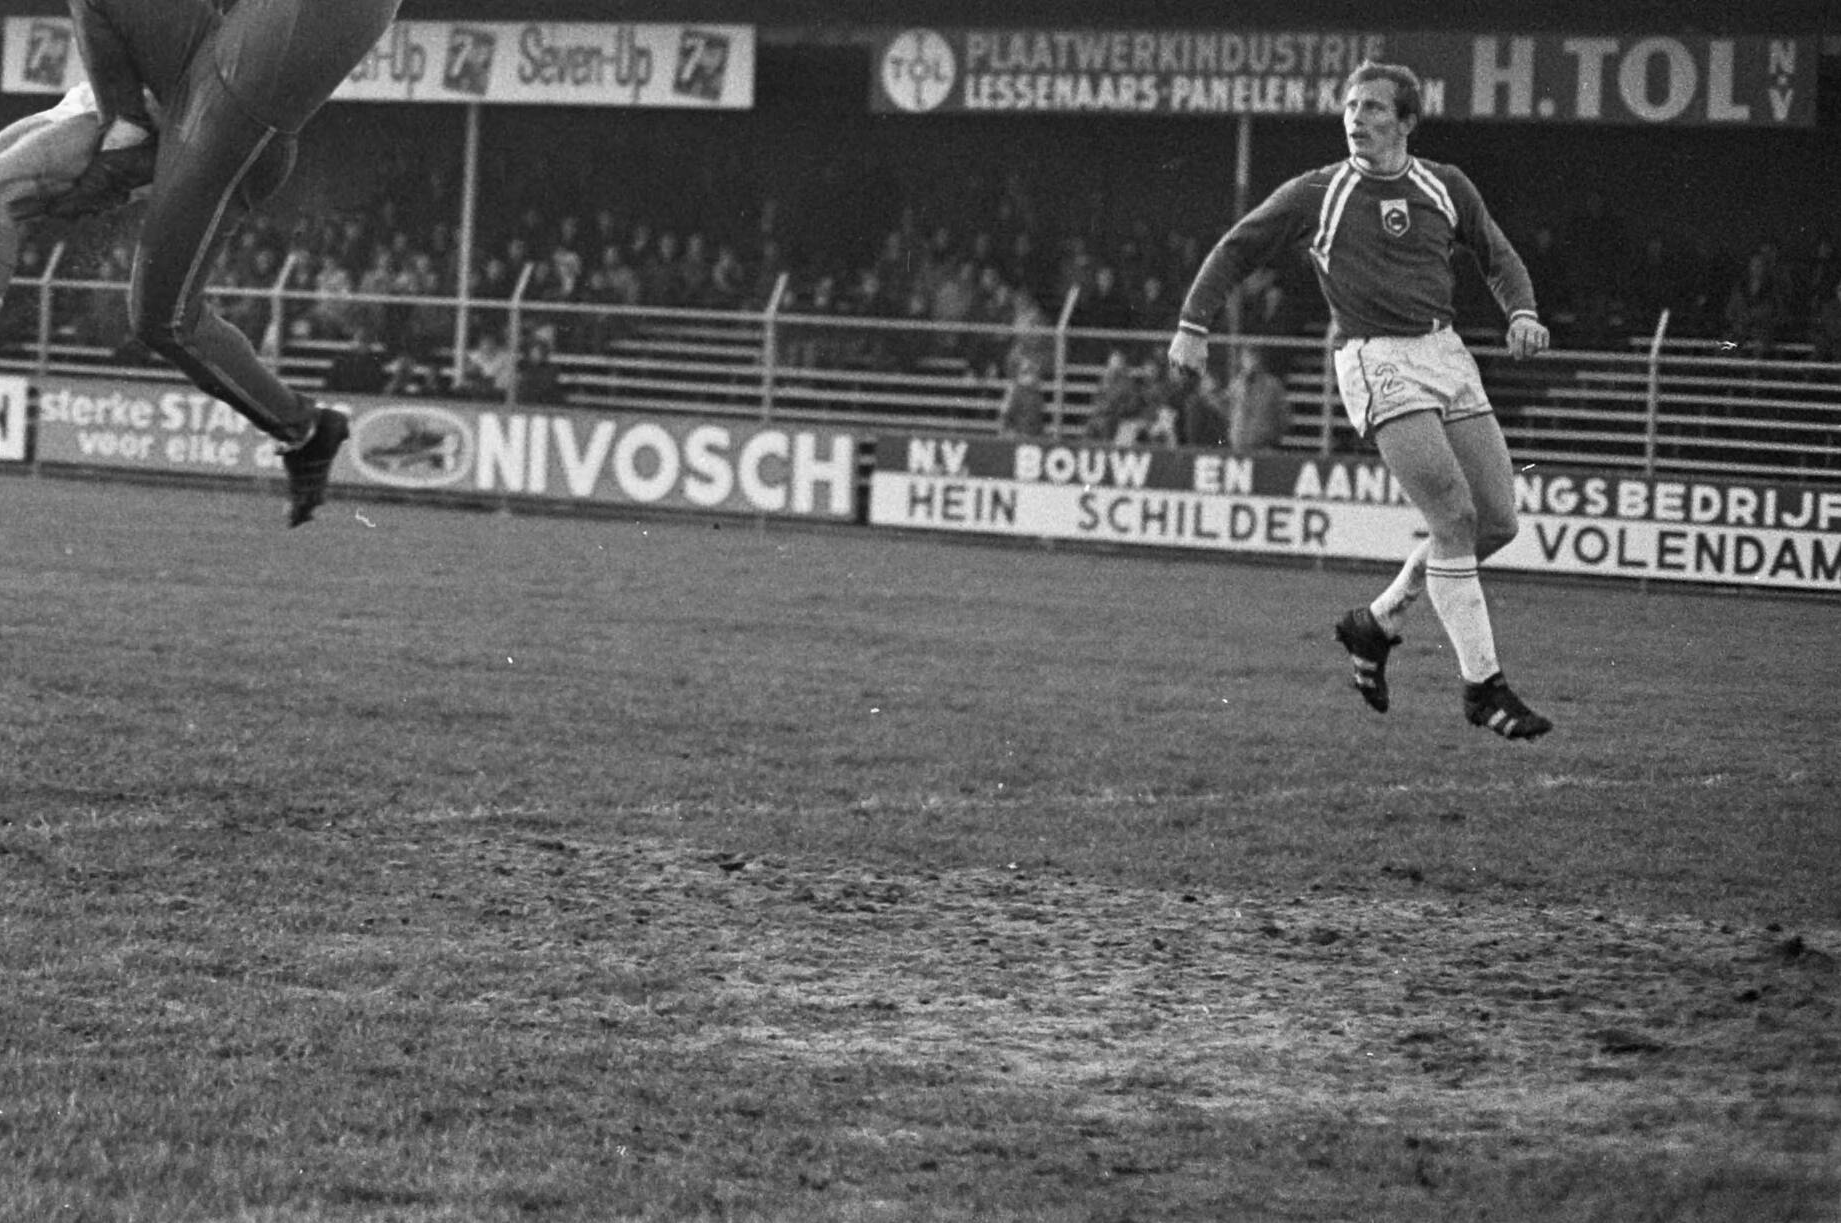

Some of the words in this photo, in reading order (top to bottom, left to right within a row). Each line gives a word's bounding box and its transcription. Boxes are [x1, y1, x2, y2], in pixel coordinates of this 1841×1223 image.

[518, 24, 654, 105] Seven-Up
[40, 391, 155, 429] sterke
[78, 431, 154, 460] voor
[165, 432, 241, 466] elke
[477, 412, 855, 518] NIVOSCH
[1014, 443, 1151, 489] BOUW
[1194, 456, 1256, 494] EN
[908, 484, 1018, 526] HEIN
[1079, 491, 1331, 546] SCHILDER
